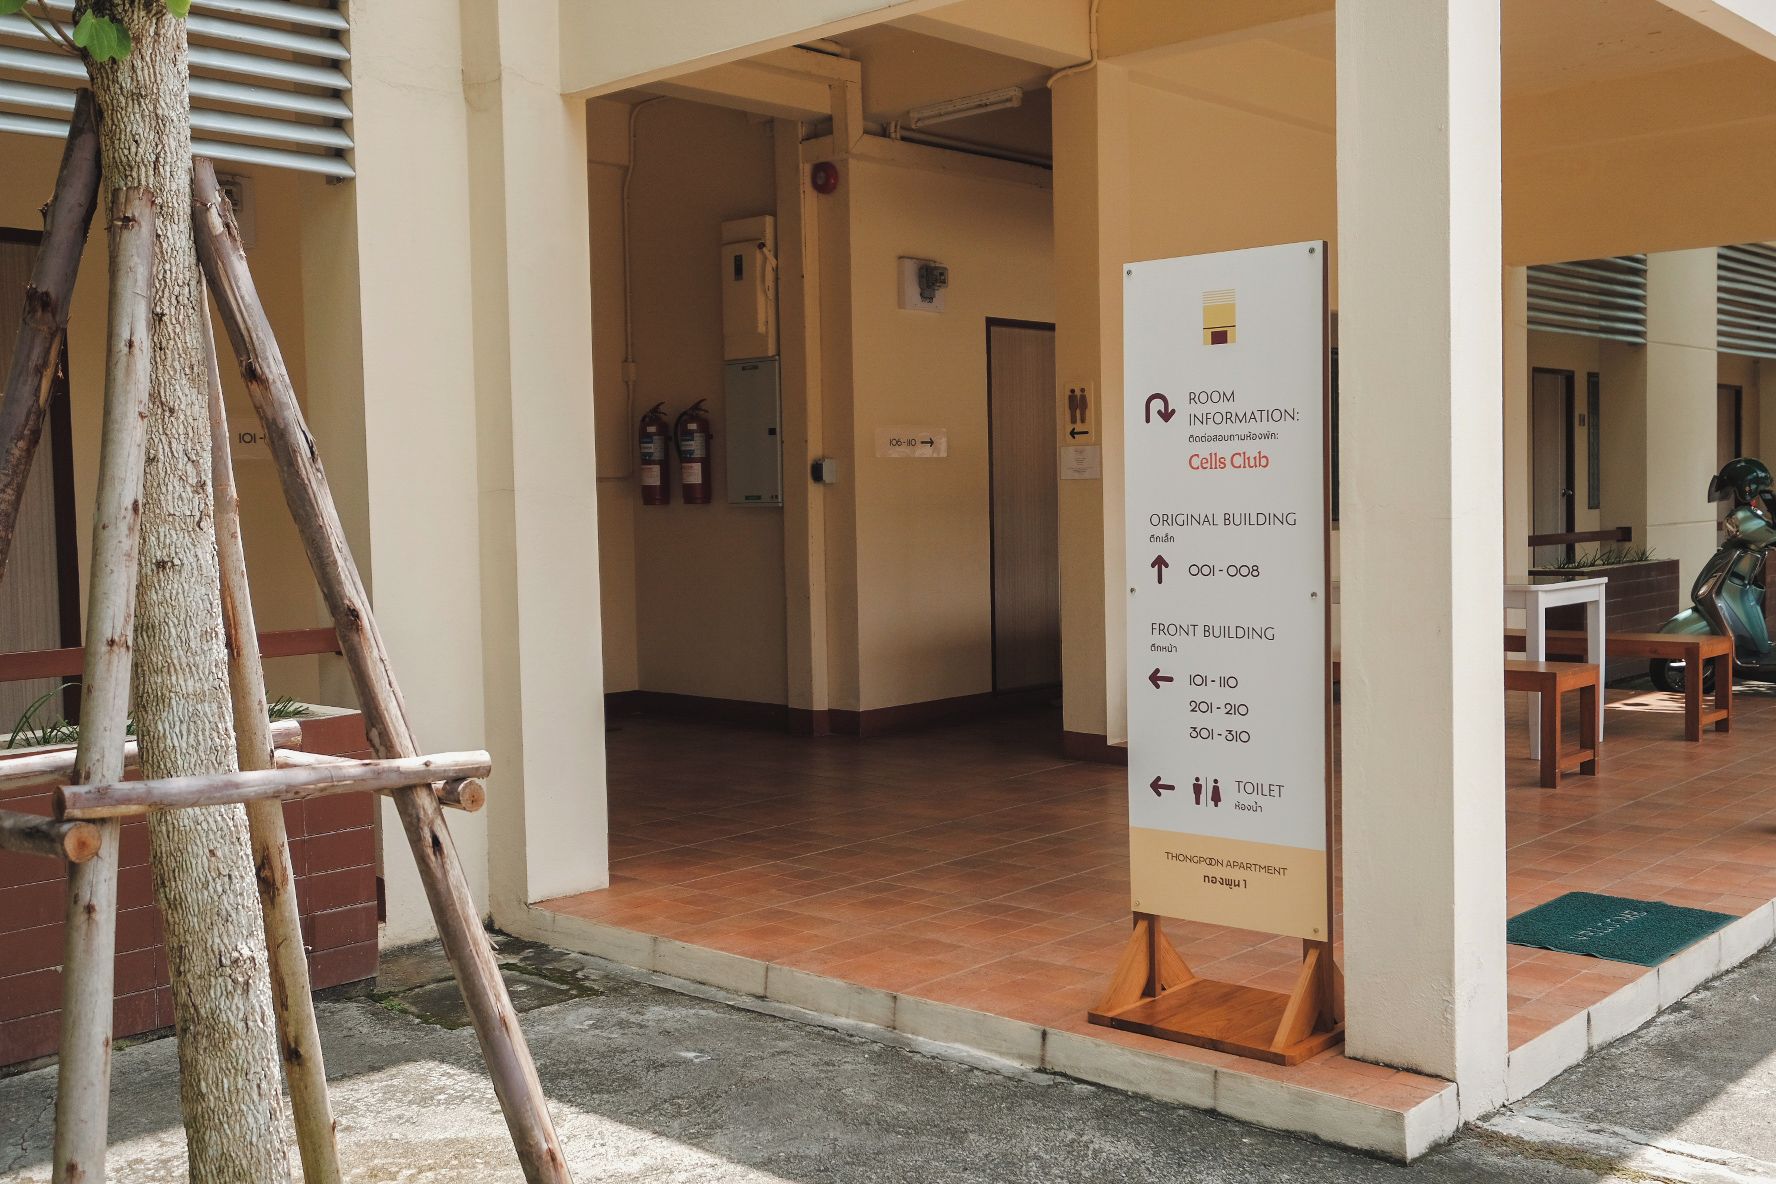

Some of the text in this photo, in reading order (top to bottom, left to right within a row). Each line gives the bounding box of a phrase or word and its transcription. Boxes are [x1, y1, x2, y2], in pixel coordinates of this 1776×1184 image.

[1188, 390, 1236, 405] ROOM
[1188, 407, 1300, 427] INFORMATION:
[1188, 450, 1269, 470] Cells Club
[1149, 512, 1297, 527] ORIGINAL BUILDING
[1150, 622, 1275, 641] FRONT BUILDING
[1234, 780, 1285, 798] TOILET
[1164, 851, 1288, 876] THONGPOON APARTMENT
